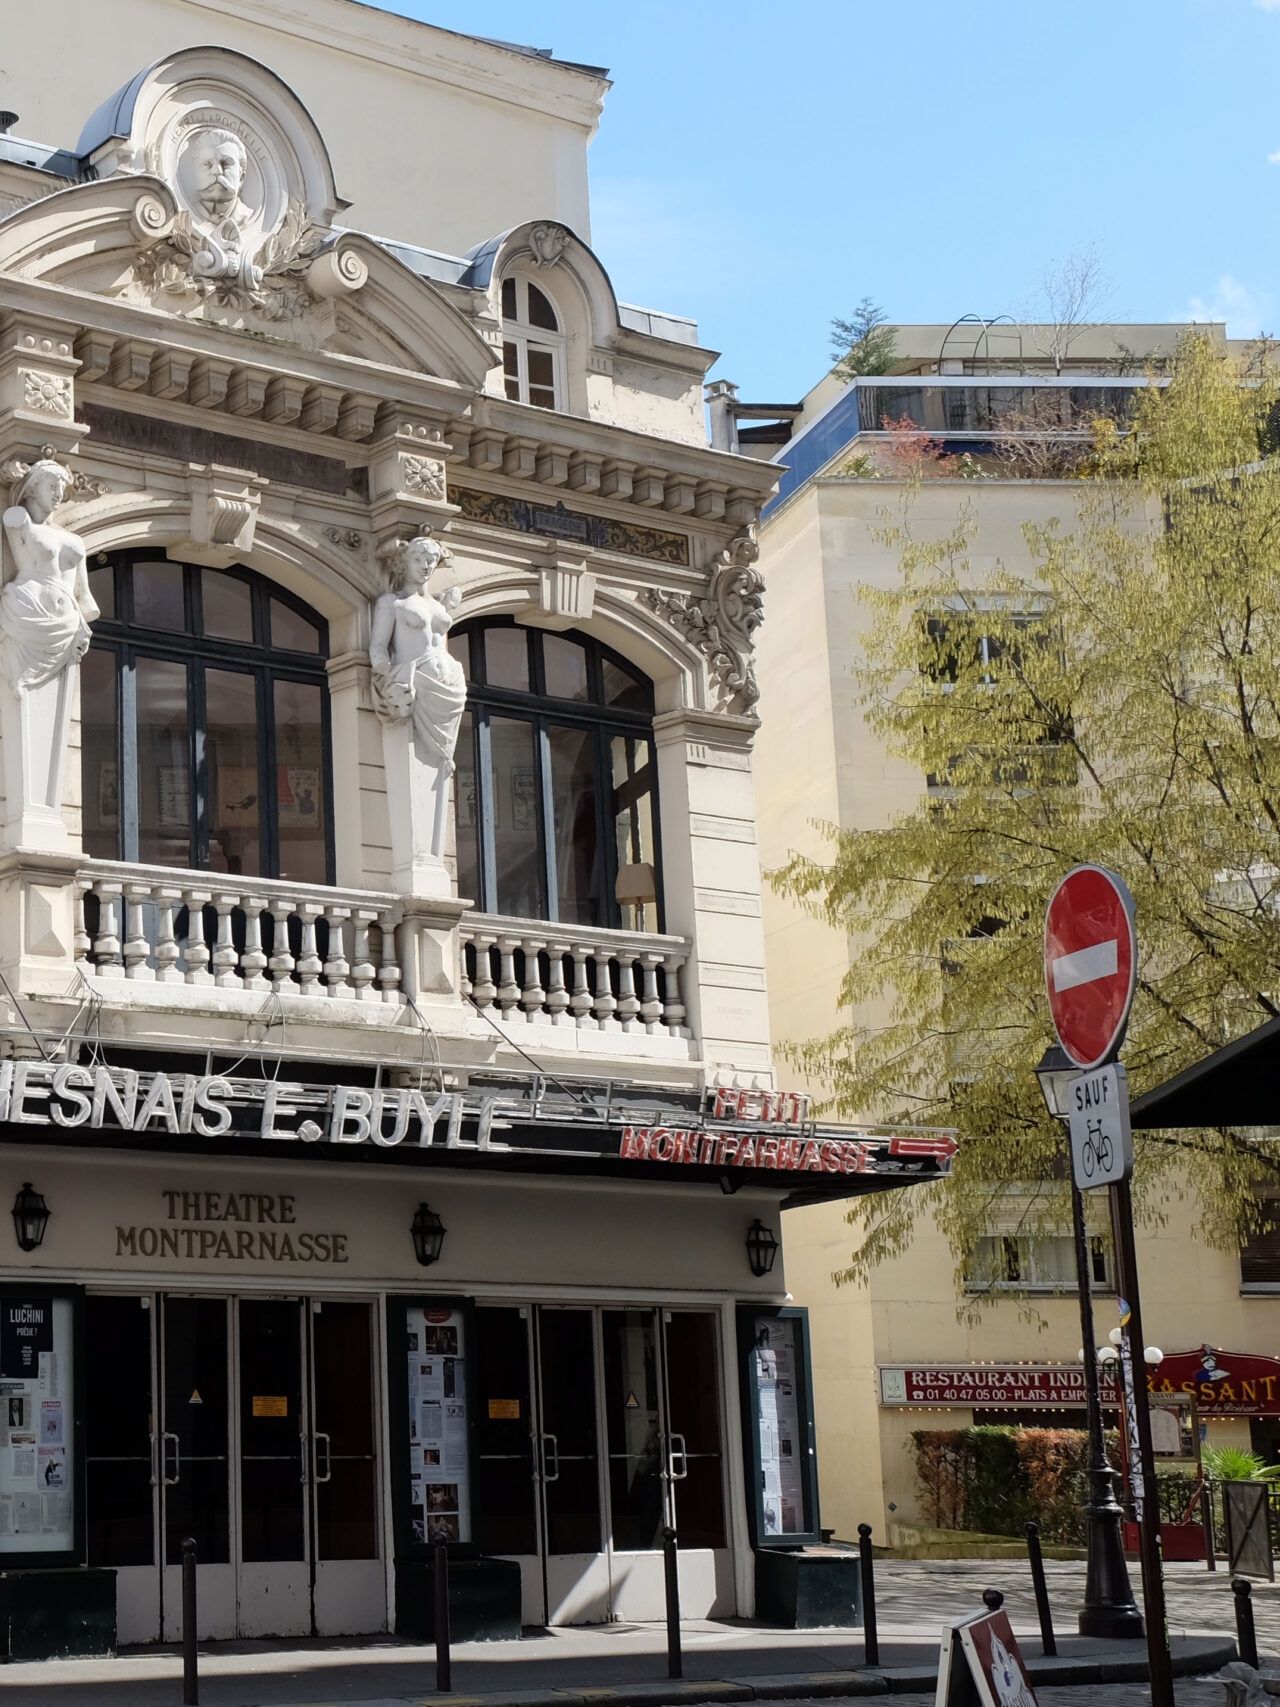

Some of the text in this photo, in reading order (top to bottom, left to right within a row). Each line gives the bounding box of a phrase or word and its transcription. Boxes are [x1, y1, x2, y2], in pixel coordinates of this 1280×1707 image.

[713, 1086, 812, 1124] PETIT
[1075, 1075, 1108, 1112] SAUF
[620, 1126, 880, 1174] MONTPARNASSE
[162, 1190, 297, 1224] THEATRE
[115, 1226, 349, 1264] MONTPARNASSE
[10, 1308, 44, 1324] LUCHINI
[911, 1371, 1042, 1387] RESTAURANT
[926, 1390, 939, 1400] 01
[943, 1390, 957, 1400] 40
[960, 1390, 973, 1400] 47
[975, 1390, 990, 1400] 05
[1014, 1389, 1047, 1401] PLATS
[1050, 1390, 1058, 1401] A
